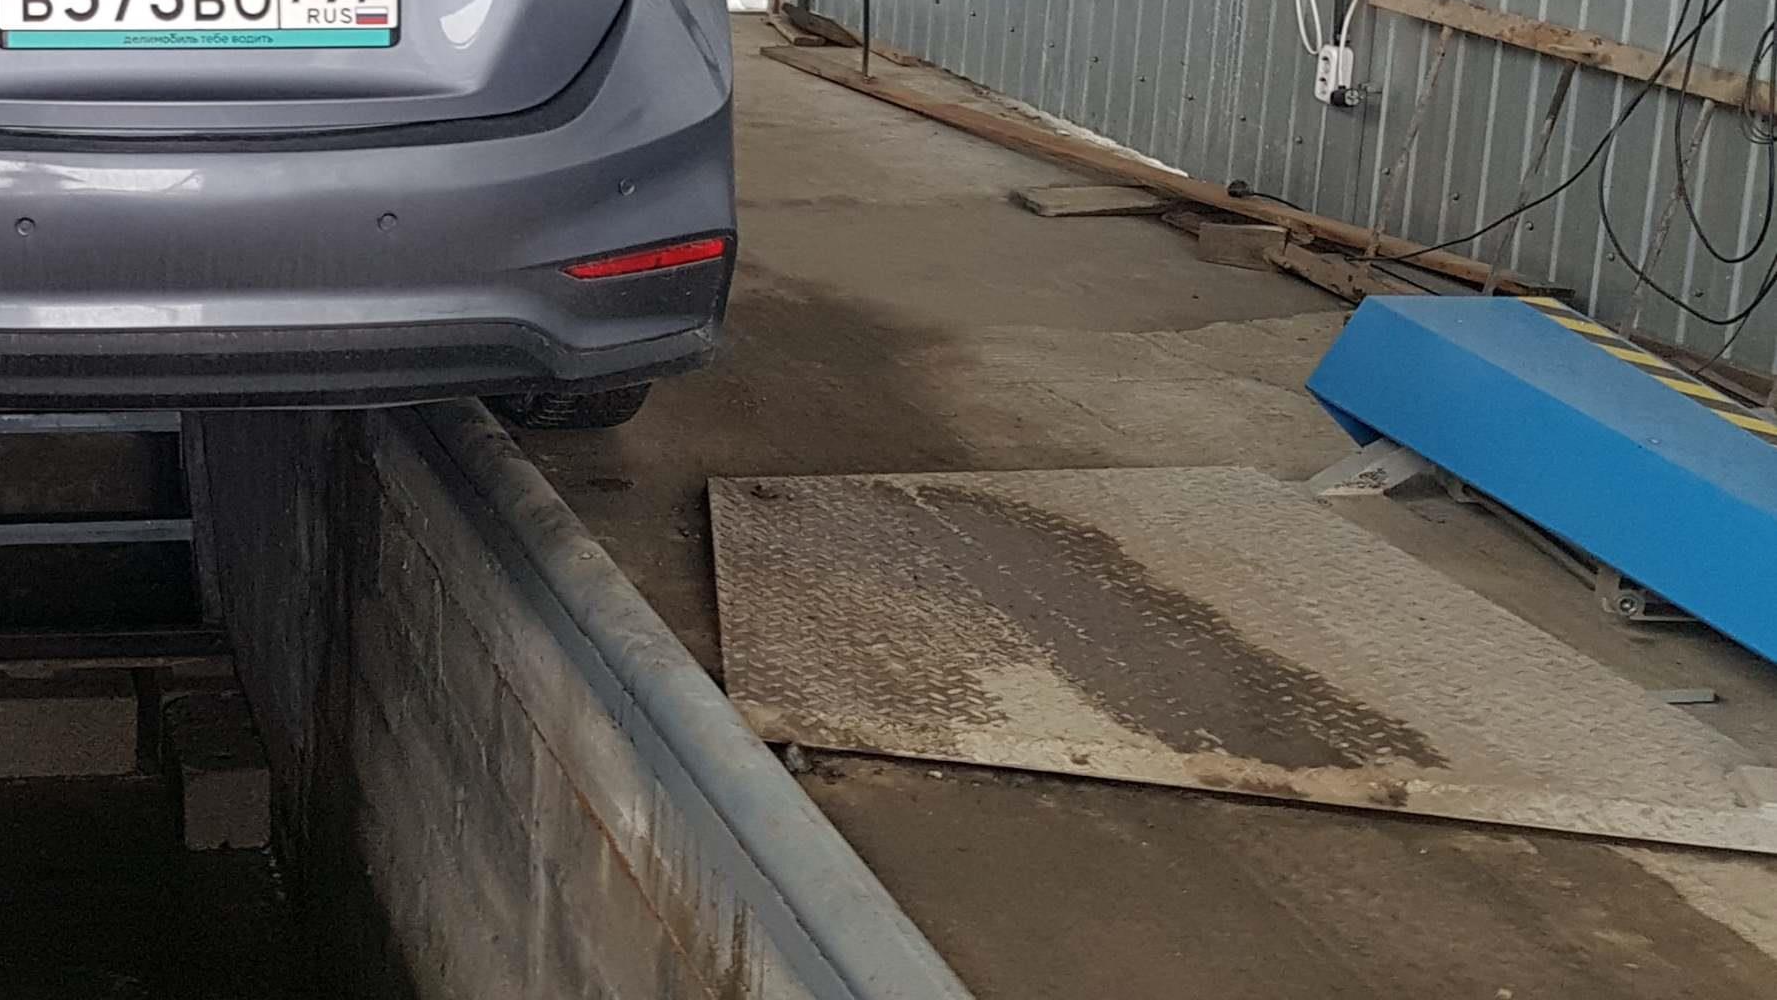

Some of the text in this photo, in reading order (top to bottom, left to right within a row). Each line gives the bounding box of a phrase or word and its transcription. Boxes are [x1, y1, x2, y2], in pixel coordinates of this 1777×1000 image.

[307, 8, 353, 24] RUS
[123, 33, 274, 45] делимобиль тебе водить
